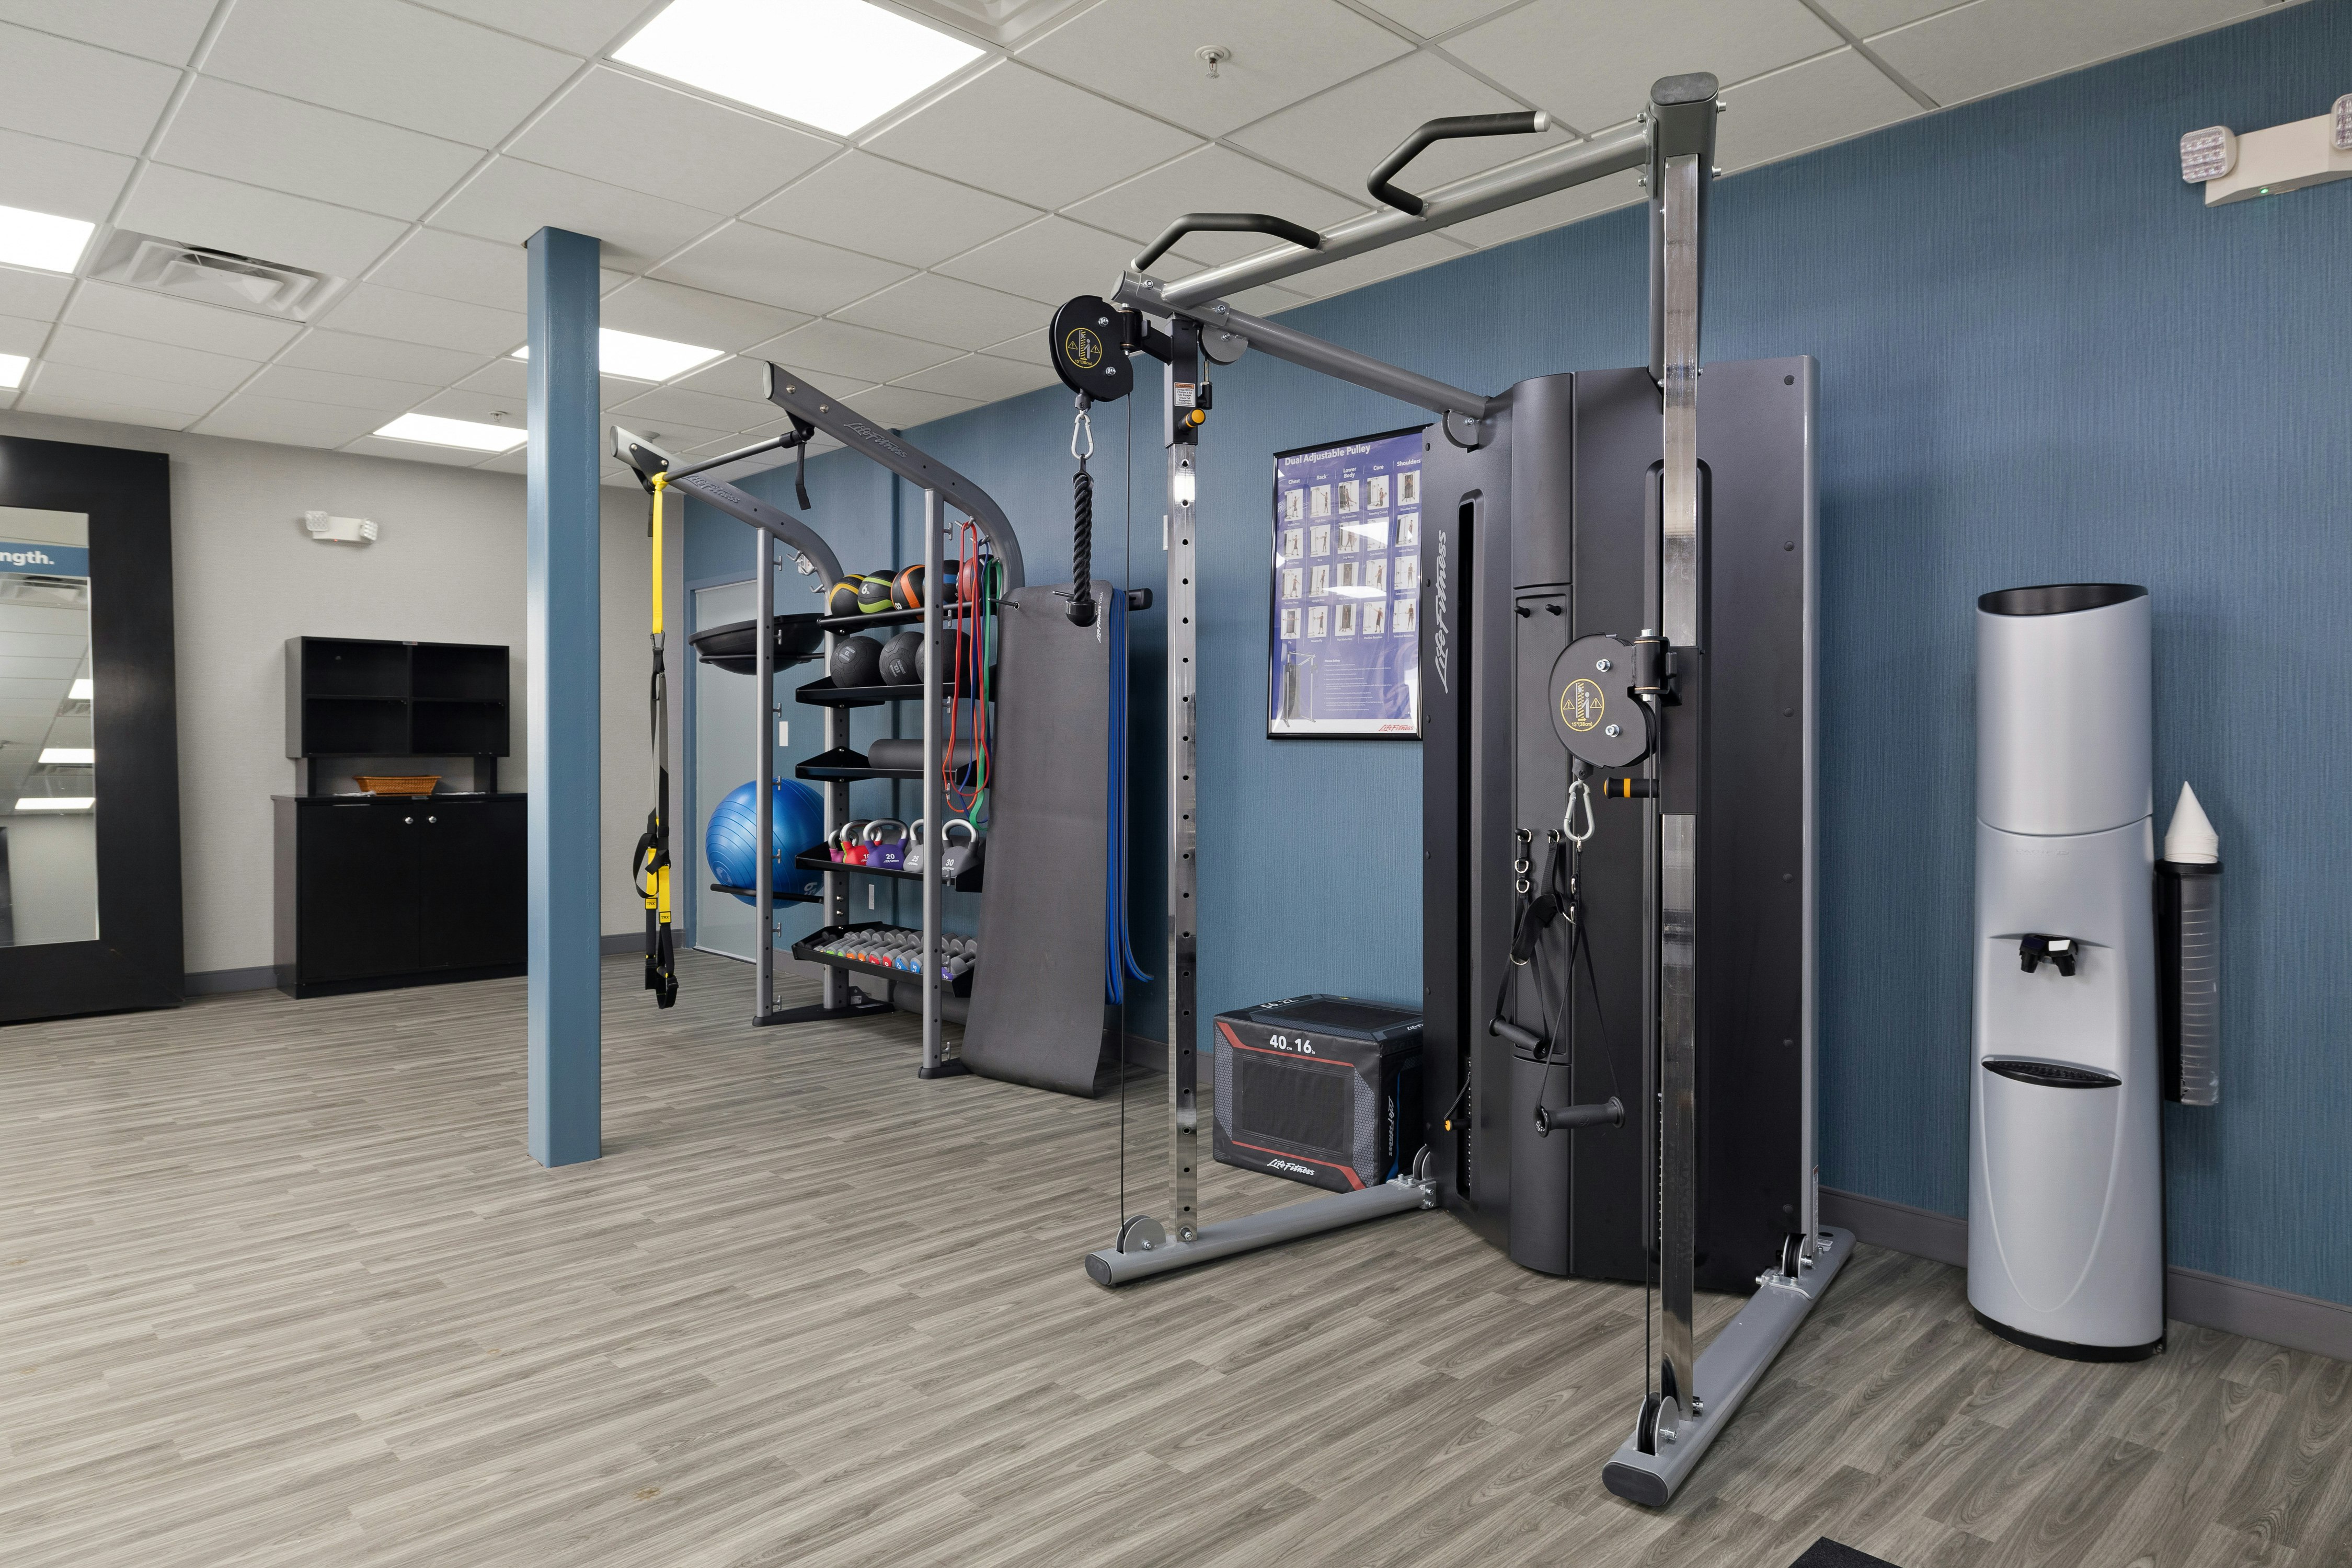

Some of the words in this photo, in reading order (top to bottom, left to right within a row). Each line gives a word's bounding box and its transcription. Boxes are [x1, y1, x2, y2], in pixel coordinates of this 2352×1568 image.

[1284, 455, 1302, 466] Dual
[1303, 448, 1345, 463] Adjustable
[1346, 444, 1371, 455] Pulley
